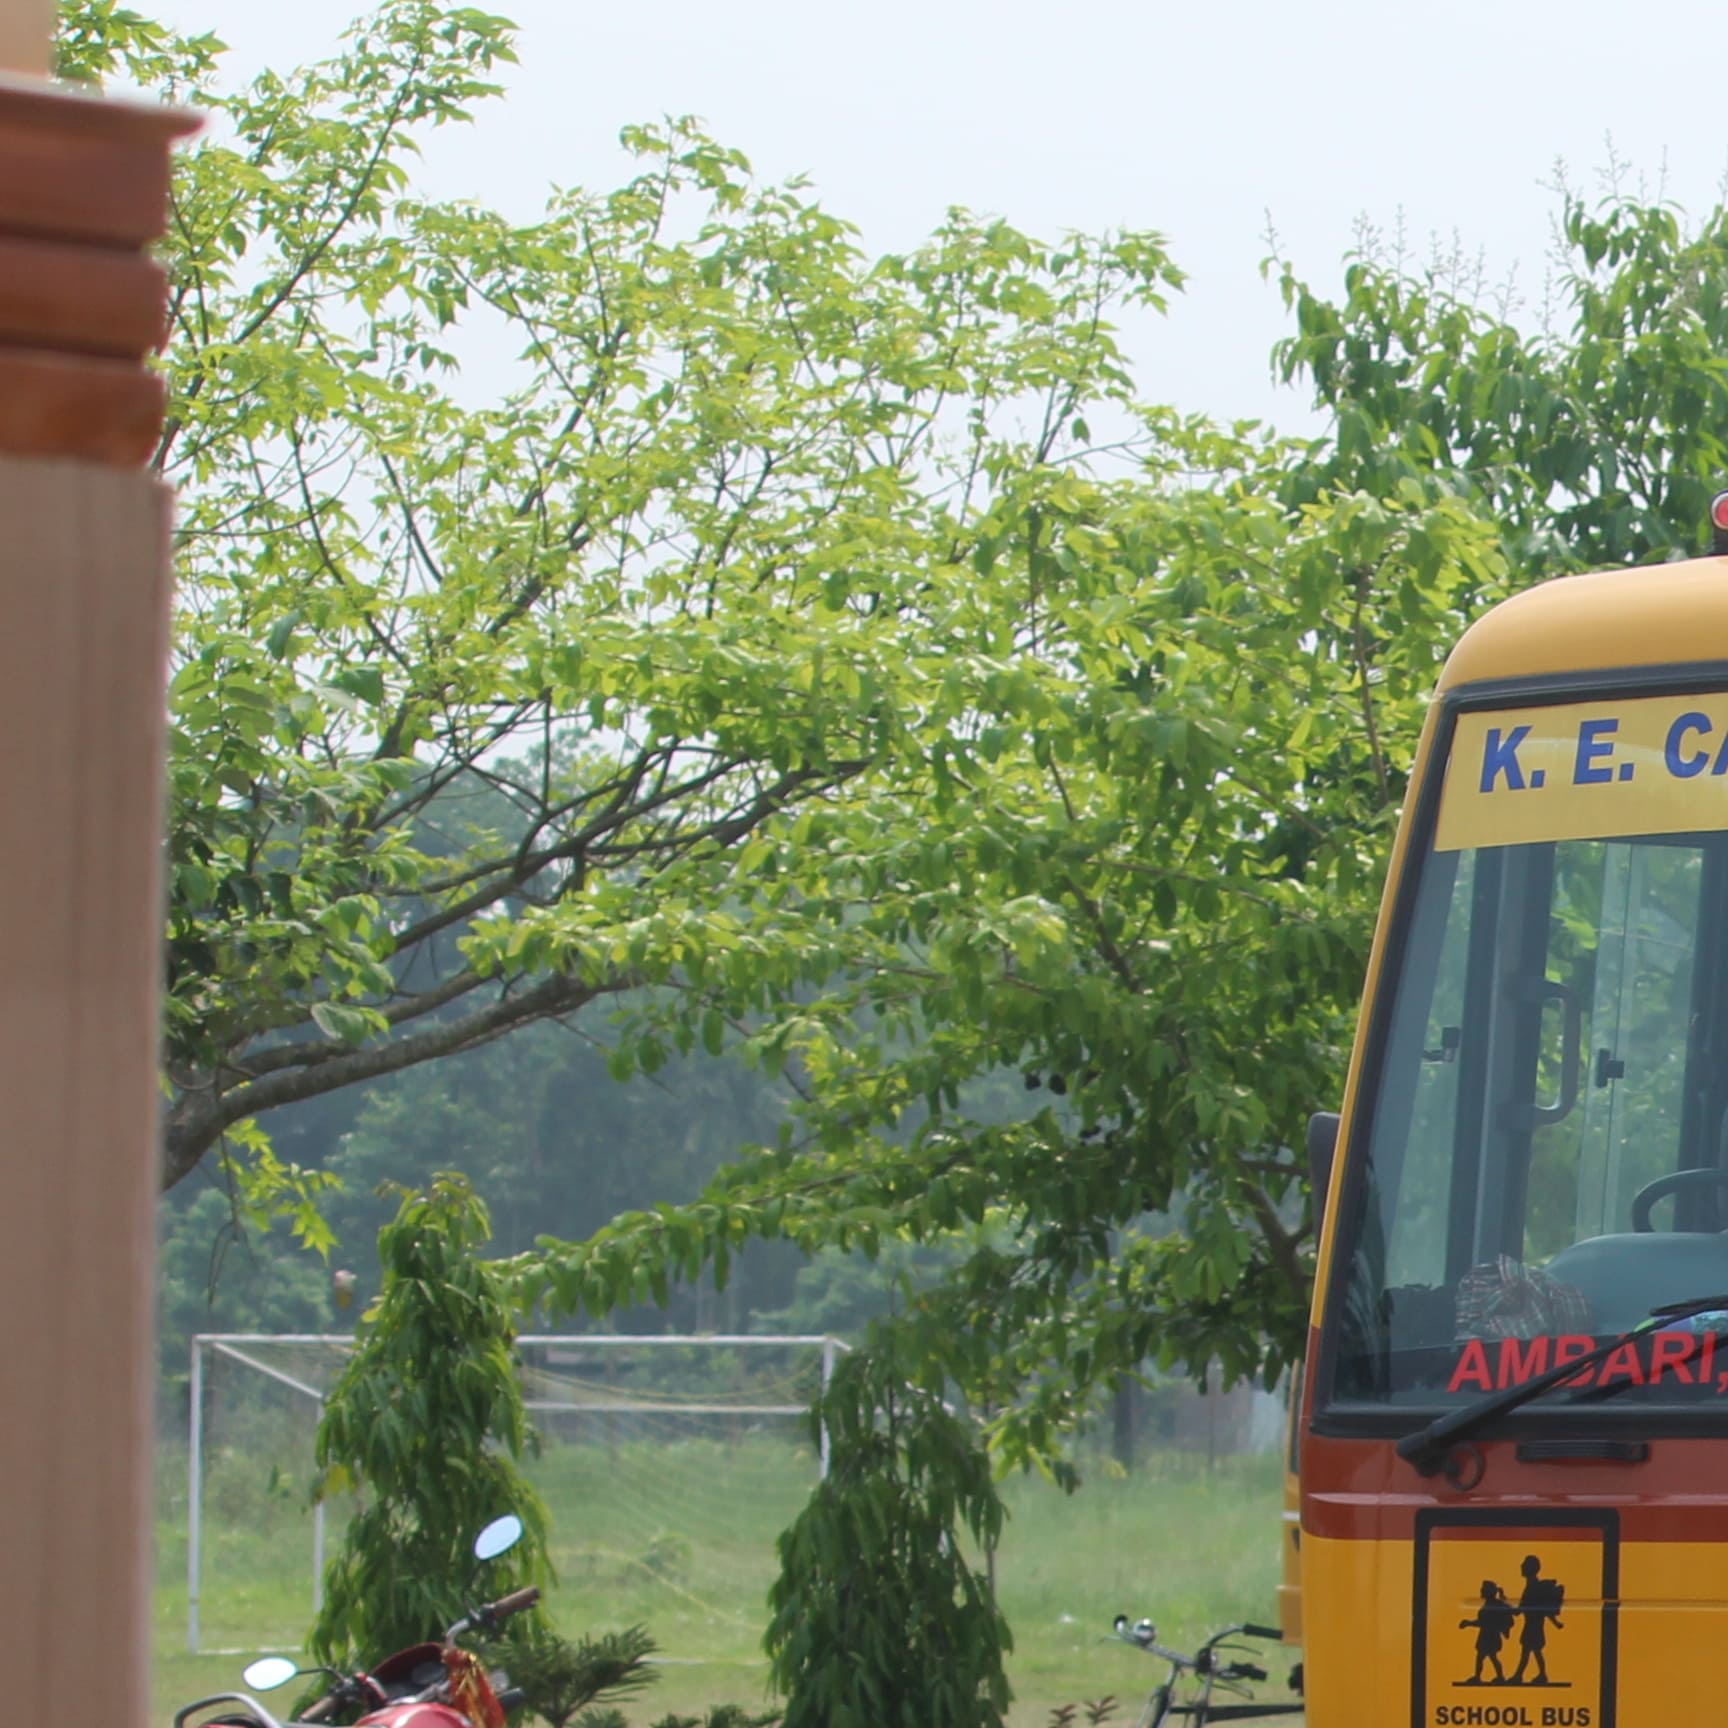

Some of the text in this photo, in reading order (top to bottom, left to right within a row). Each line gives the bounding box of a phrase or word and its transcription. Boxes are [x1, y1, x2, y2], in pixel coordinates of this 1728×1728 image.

[1479, 725, 1546, 793] K.
[1572, 718, 1634, 786] E.
[1435, 1705, 1591, 1727] SCHOOL BUS
